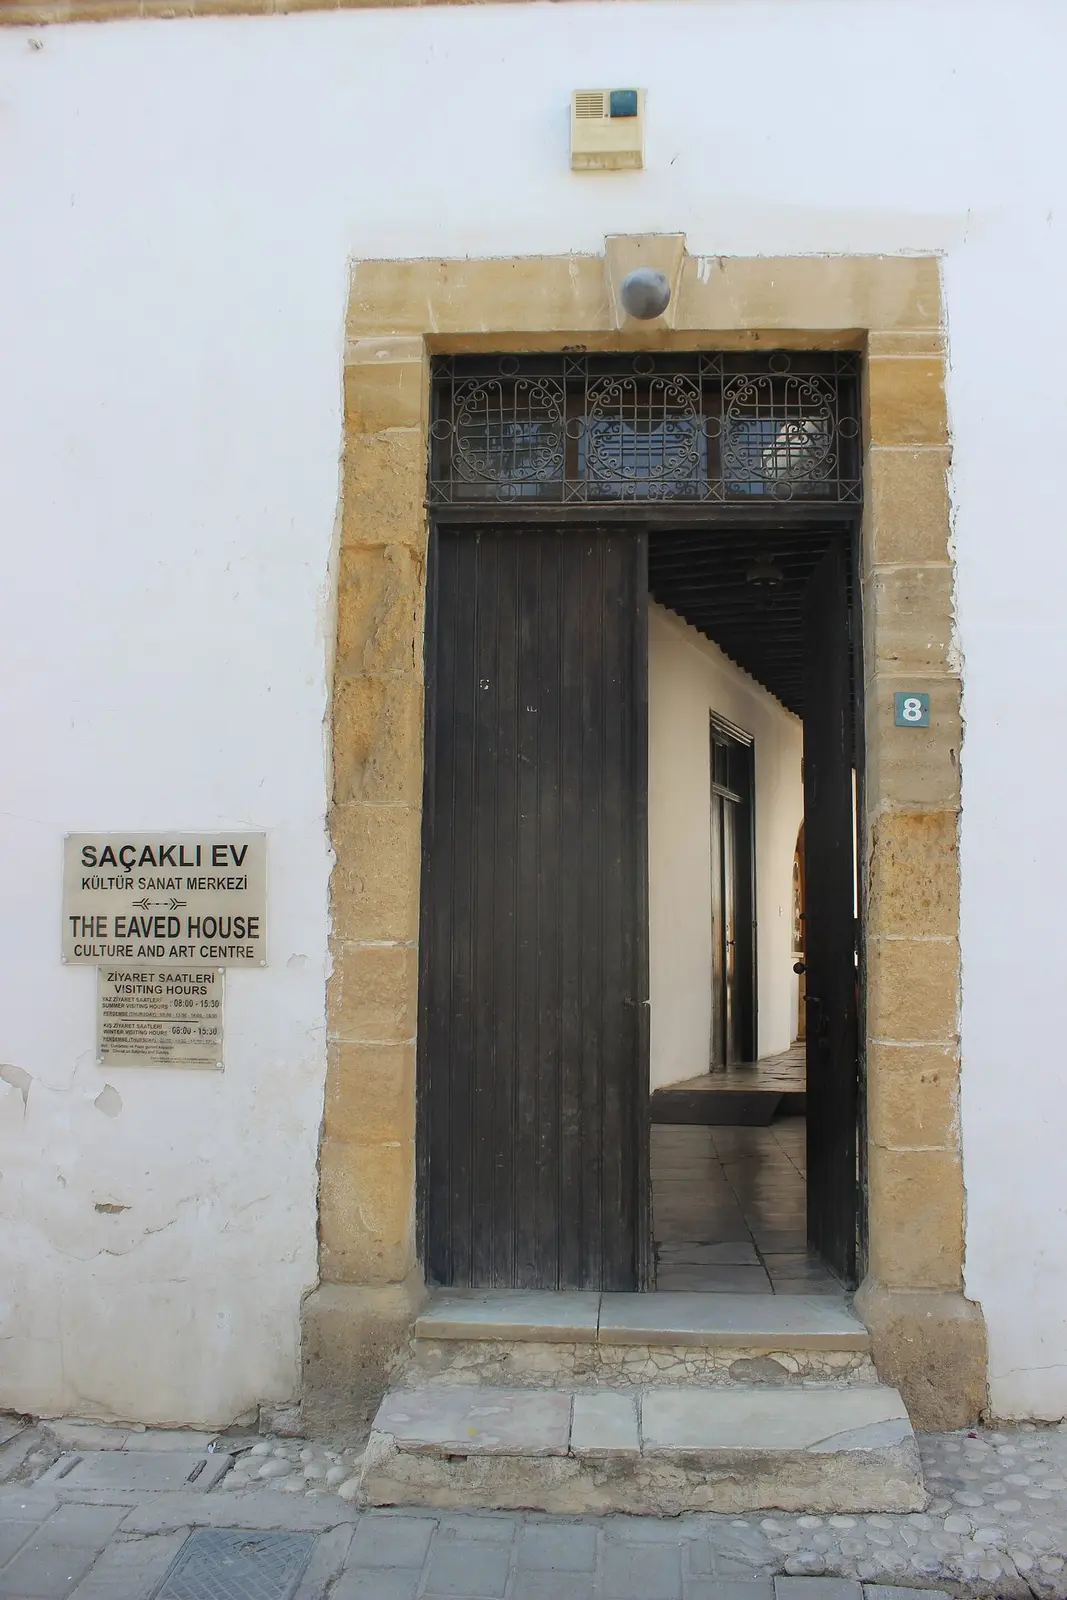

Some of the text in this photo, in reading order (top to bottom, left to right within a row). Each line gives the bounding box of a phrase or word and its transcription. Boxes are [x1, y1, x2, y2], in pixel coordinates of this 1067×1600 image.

[903, 698, 922, 721] 8
[81, 844, 249, 873] SAÇAKLI EV
[82, 875, 248, 890] KÜLTÜR SANAT MERKEZİ
[69, 916, 260, 939] THE EAVED HOUSE
[74, 944, 254, 959] CULTURE AND ART CENTRE
[107, 970, 215, 984] ZİYARET SAATLERİ
[114, 984, 208, 995] VISITING HOURS
